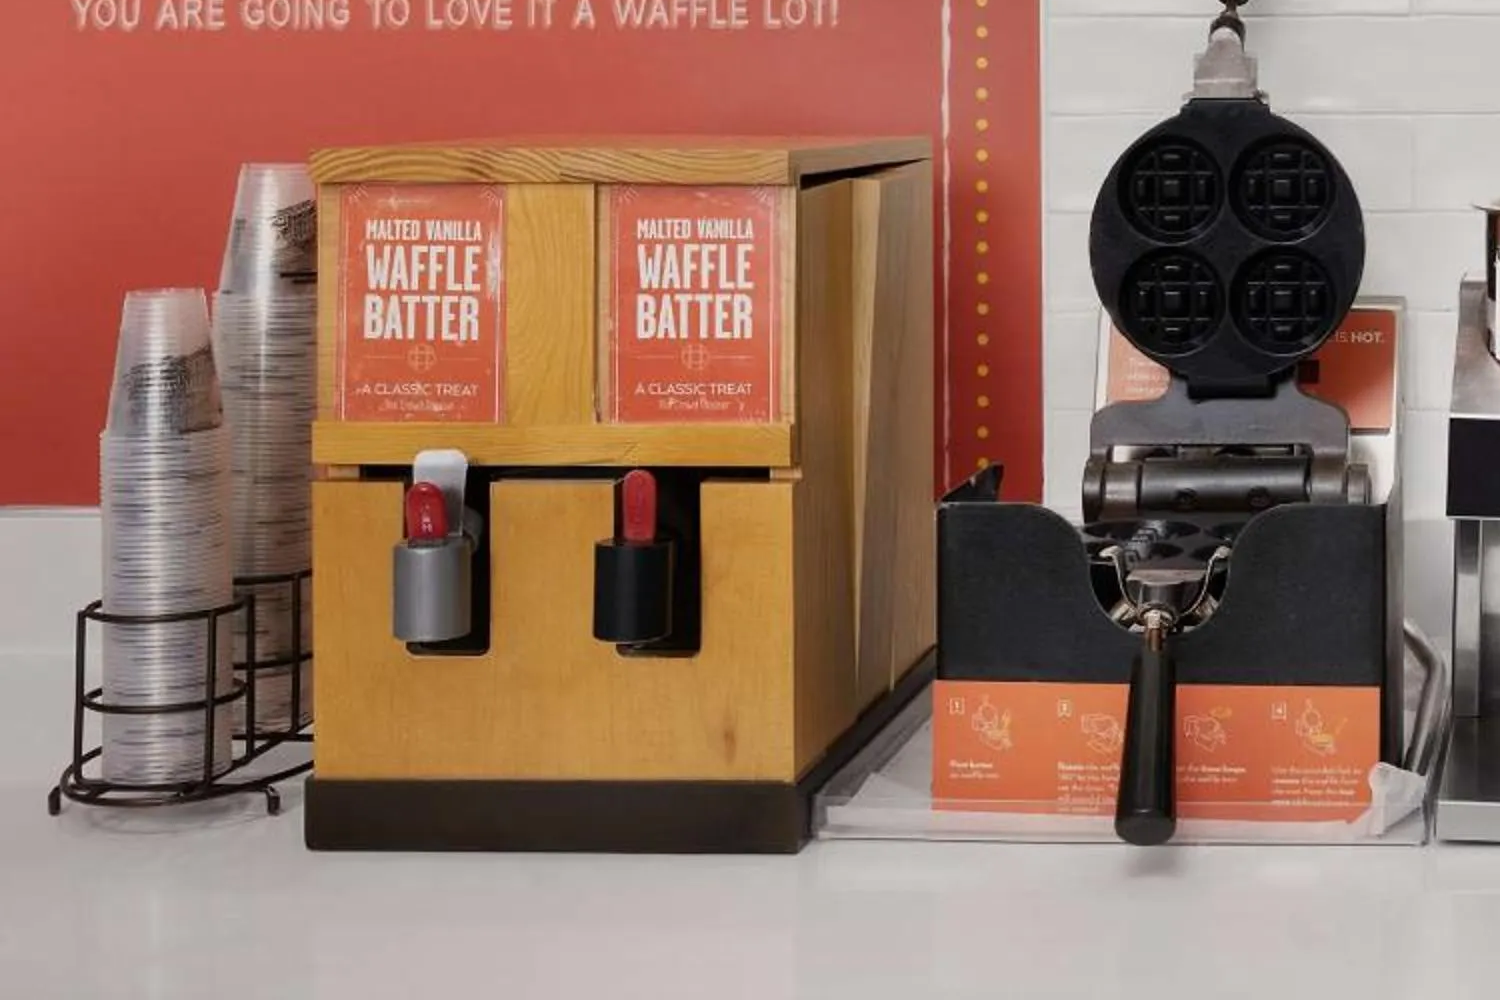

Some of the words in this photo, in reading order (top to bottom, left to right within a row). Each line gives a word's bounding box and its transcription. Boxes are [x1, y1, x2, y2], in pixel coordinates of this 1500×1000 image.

[366, 219, 421, 240] MALTED
[426, 220, 482, 240] VANILLA
[637, 217, 690, 239] MALTED
[697, 217, 753, 239] VANILLA
[366, 245, 481, 291] WAFFLE
[637, 243, 755, 290] WAFFLE
[363, 294, 479, 341] BATTER
[637, 293, 753, 340] BATTER
[361, 384, 371, 395] A
[374, 383, 432, 396] CLASSIC
[437, 384, 478, 397] TREAT
[635, 384, 645, 396] A
[649, 383, 706, 396] CLASSIC
[711, 383, 752, 396] TREAT
